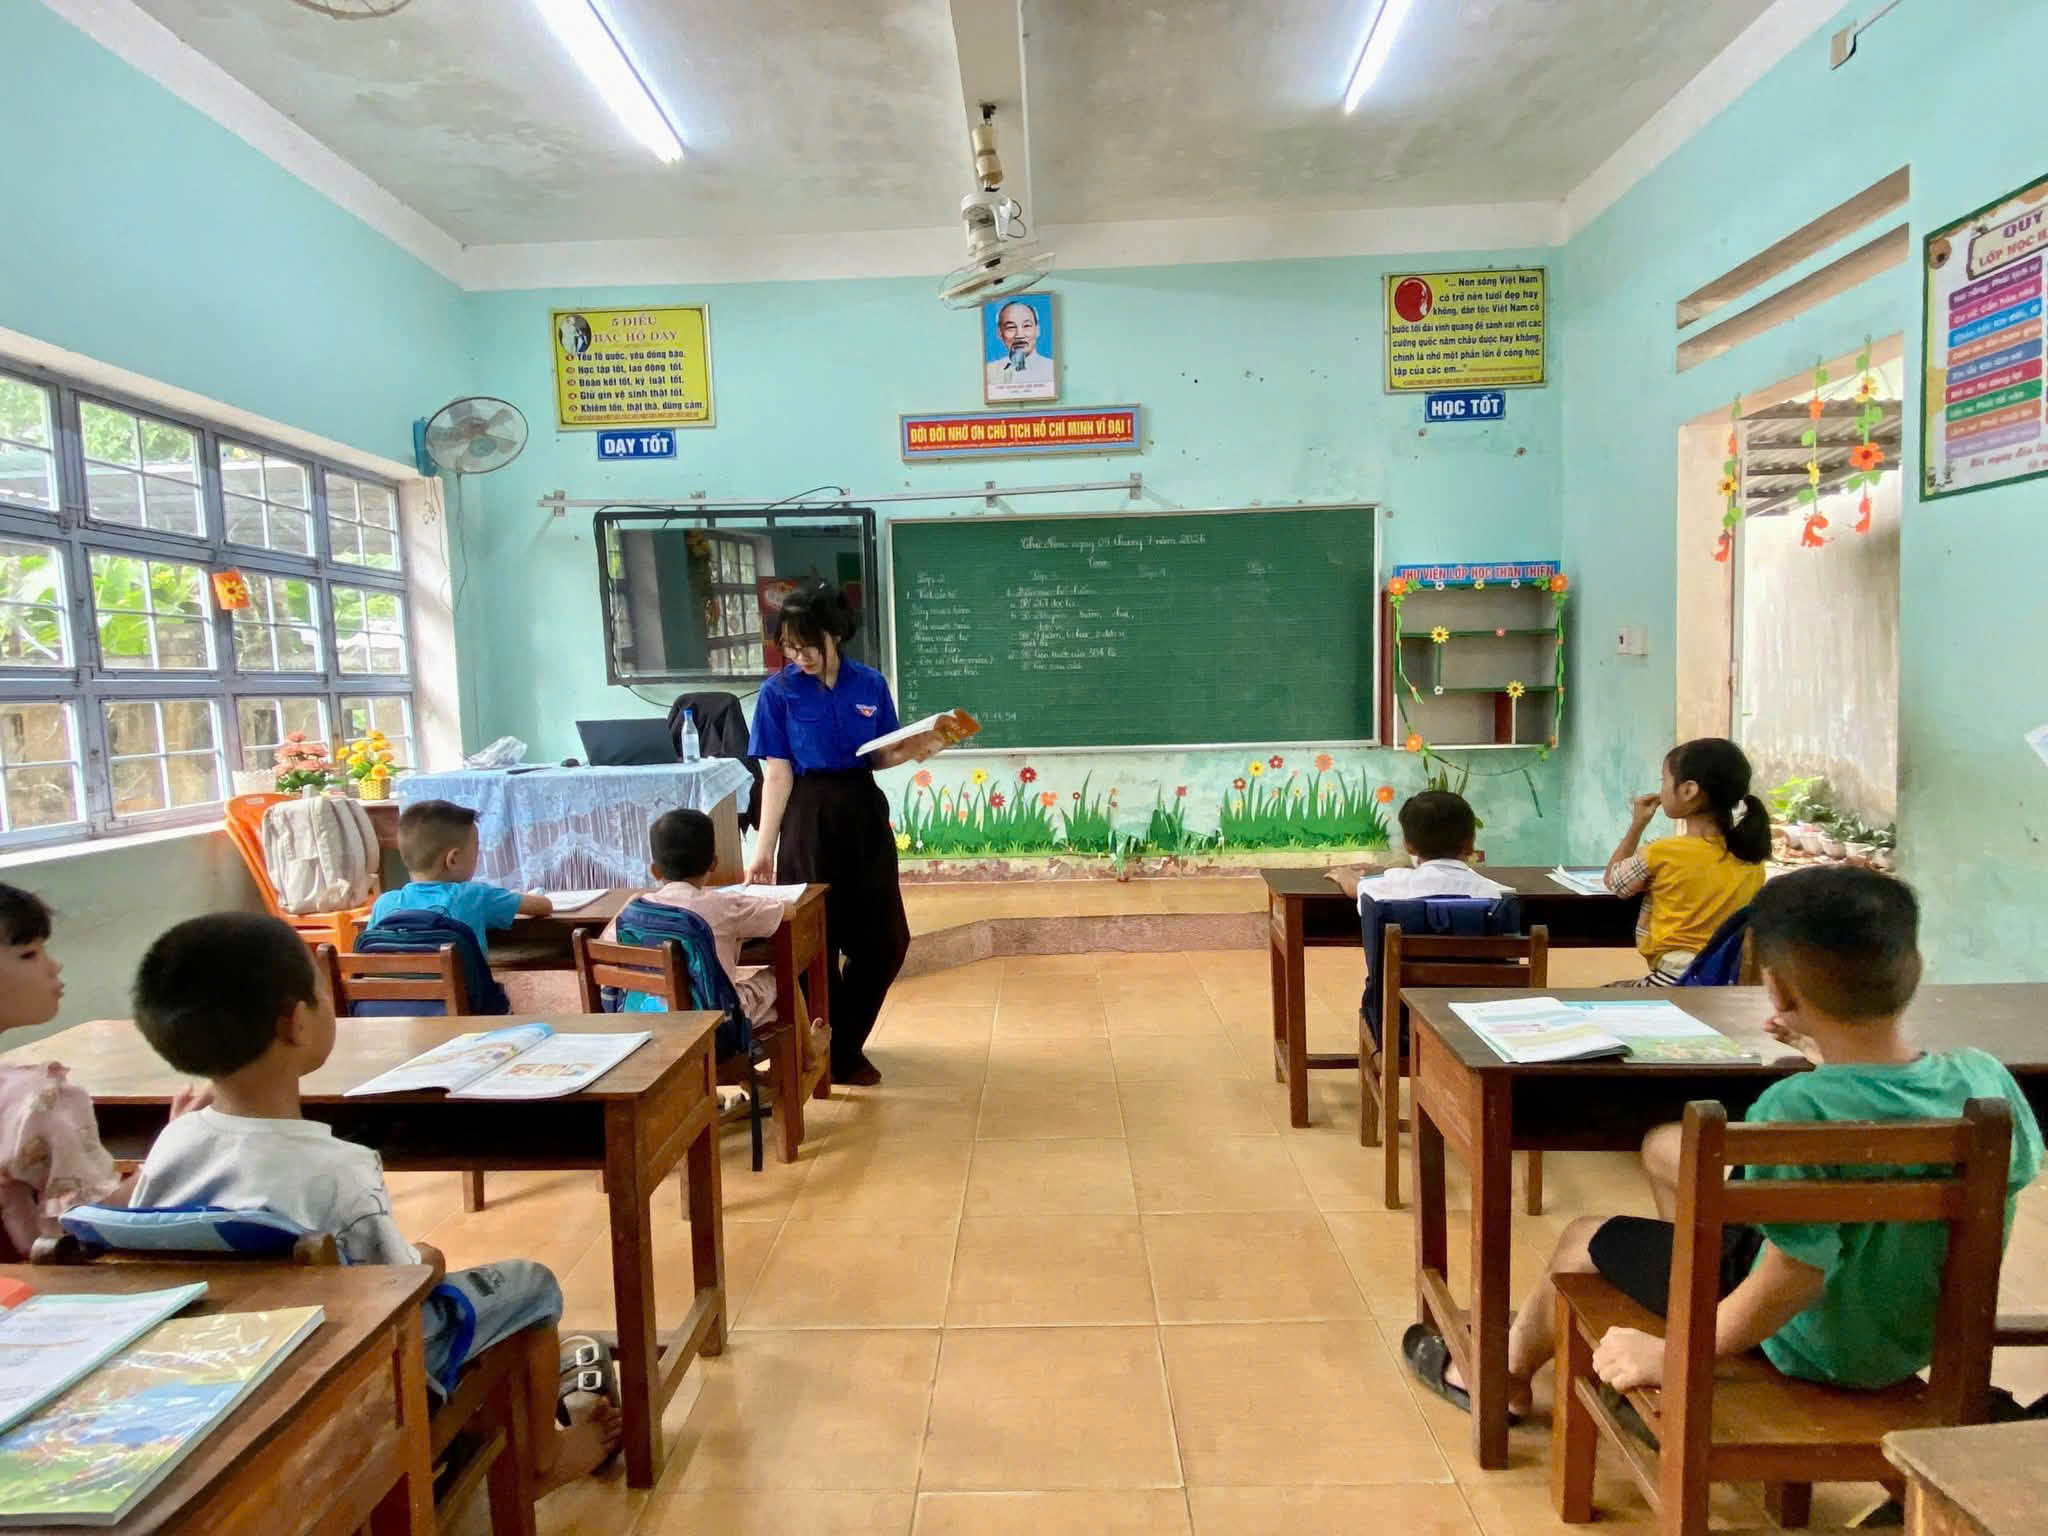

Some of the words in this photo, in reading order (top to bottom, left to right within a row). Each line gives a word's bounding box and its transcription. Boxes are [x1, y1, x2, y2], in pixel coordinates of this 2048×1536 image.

[1459, 277, 1476, 287] Non
[1478, 277, 1497, 288] sông
[1500, 275, 1516, 286] Việt
[1519, 275, 1538, 284] Nam
[1523, 288, 1538, 300] hay
[1510, 303, 1528, 312] Nam
[612, 318, 619, 327] 5
[1431, 400, 1465, 419] HỌC
[1470, 394, 1500, 414] TỐT
[910, 424, 927, 443] ĐỜI
[929, 424, 946, 442] ĐỜI
[971, 423, 984, 440] ƠN
[987, 419, 1007, 440] CHỦ
[1009, 422, 1031, 443] TỊCH
[1033, 417, 1047, 438] HỒ
[1049, 418, 1065, 437] CHÍ
[1067, 420, 1093, 436] MINH
[1108, 417, 1125, 438] ĐẠI
[604, 438, 636, 456] DẠY
[640, 433, 670, 453] TỐT
